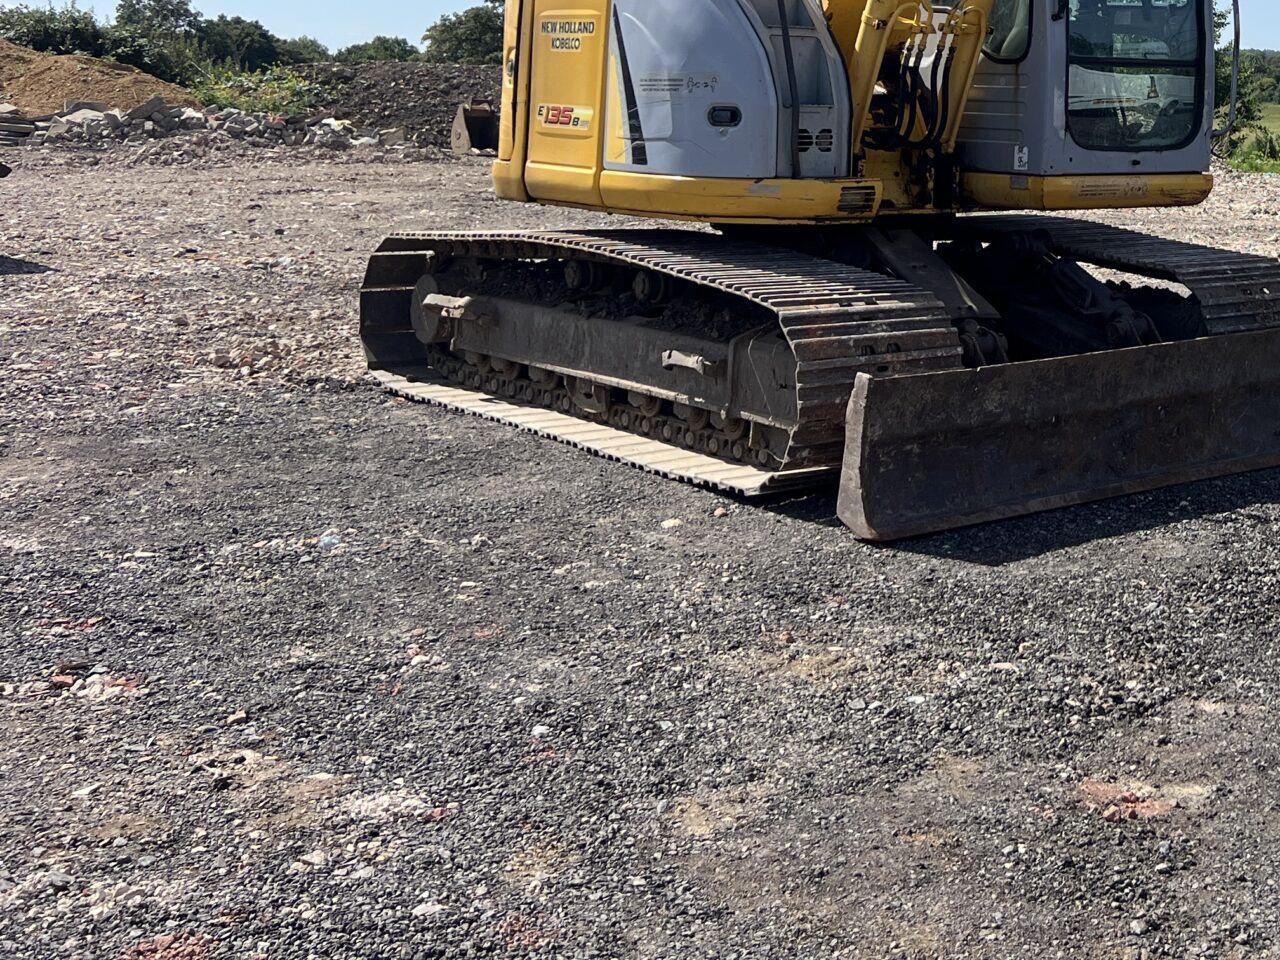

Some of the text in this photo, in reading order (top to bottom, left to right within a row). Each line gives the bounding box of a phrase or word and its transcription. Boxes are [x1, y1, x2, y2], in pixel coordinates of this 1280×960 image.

[541, 21, 595, 34] NEW HOLLAND
[552, 37, 581, 50] KOBELCO
